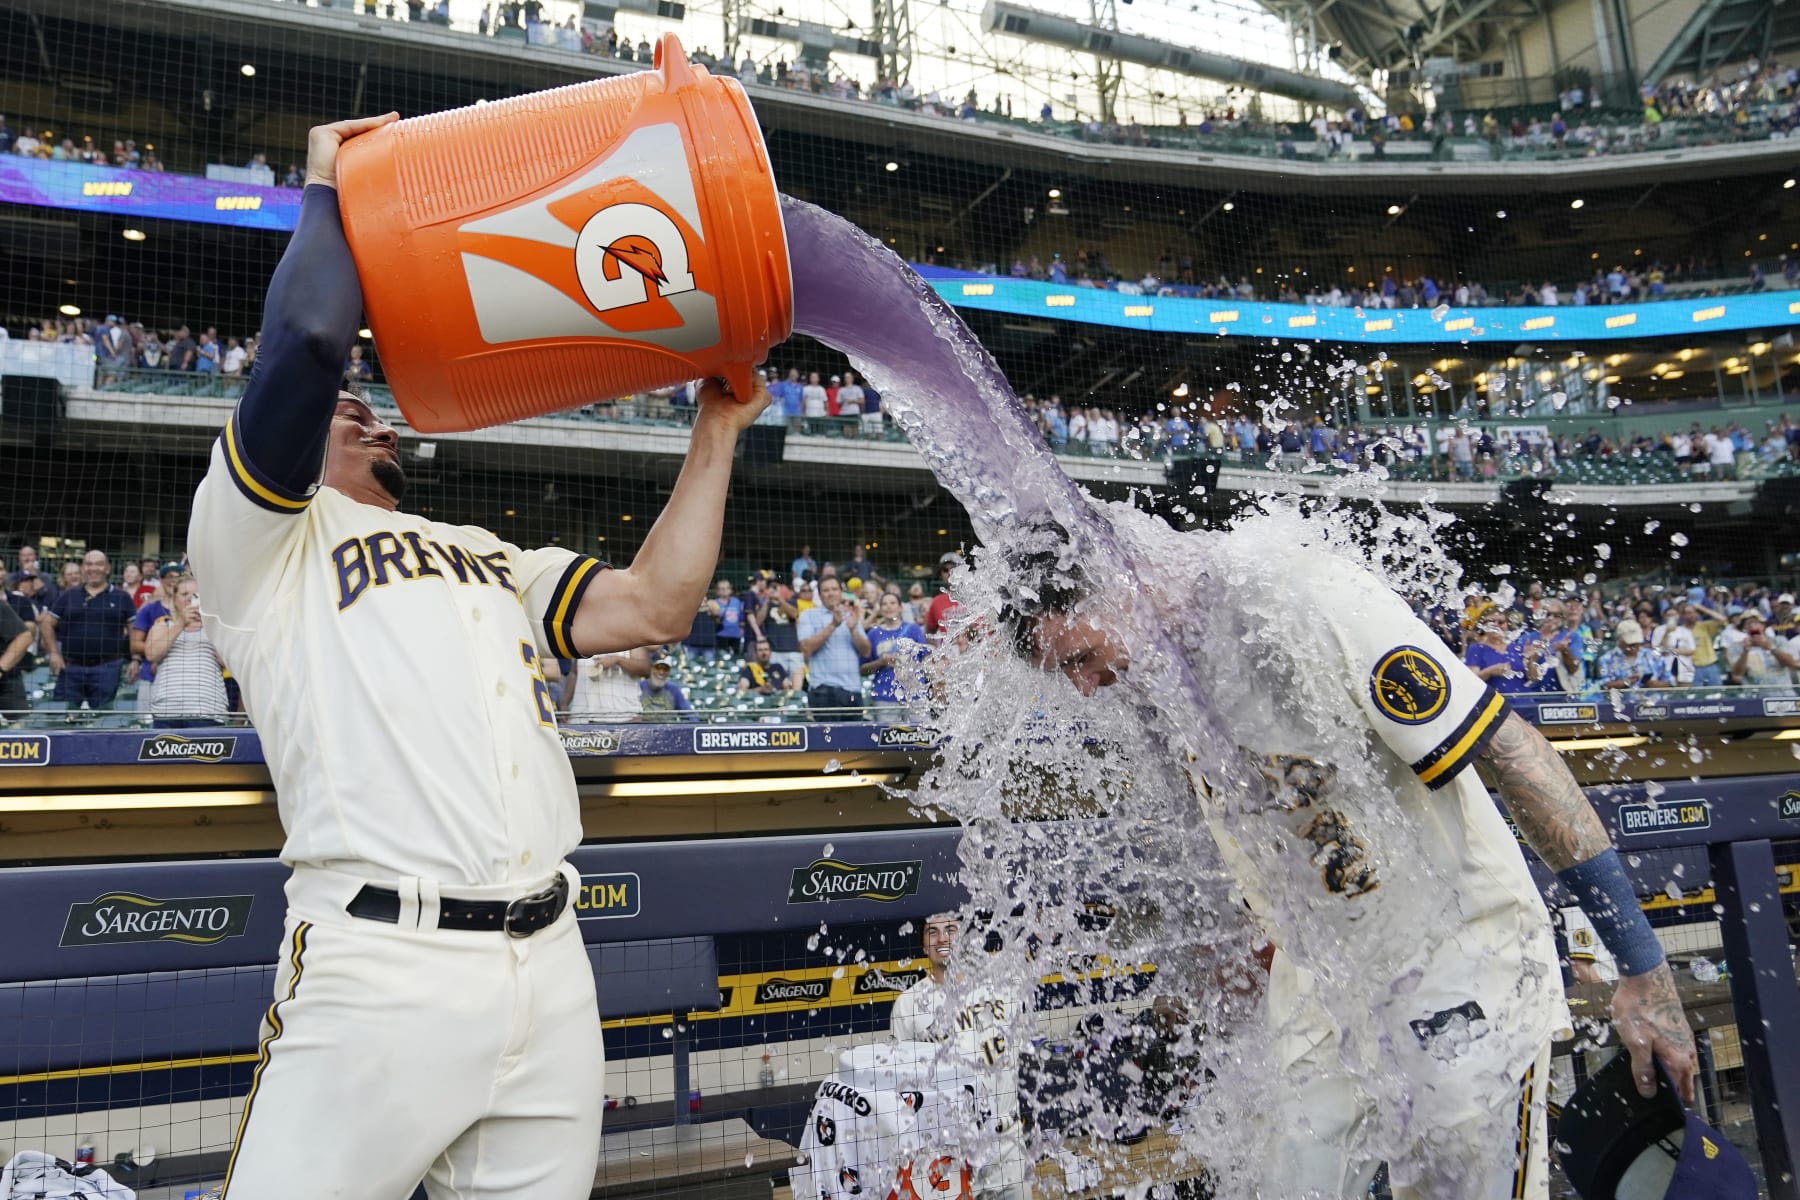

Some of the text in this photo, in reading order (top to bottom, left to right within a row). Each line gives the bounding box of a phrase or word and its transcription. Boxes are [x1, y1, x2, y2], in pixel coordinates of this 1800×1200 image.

[83, 182, 132, 196] WIN
[216, 196, 262, 210] WIN
[558, 734, 612, 749] ARGENTO
[701, 731, 801, 748] BREWERS.COM
[149, 740, 225, 757] SARGENTO
[1625, 806, 1705, 829] BREWERS.COM
[802, 870, 906, 896] SARGENTO
[81, 906, 230, 937] SARGENTO
[762, 983, 824, 1001] SARGENTO
